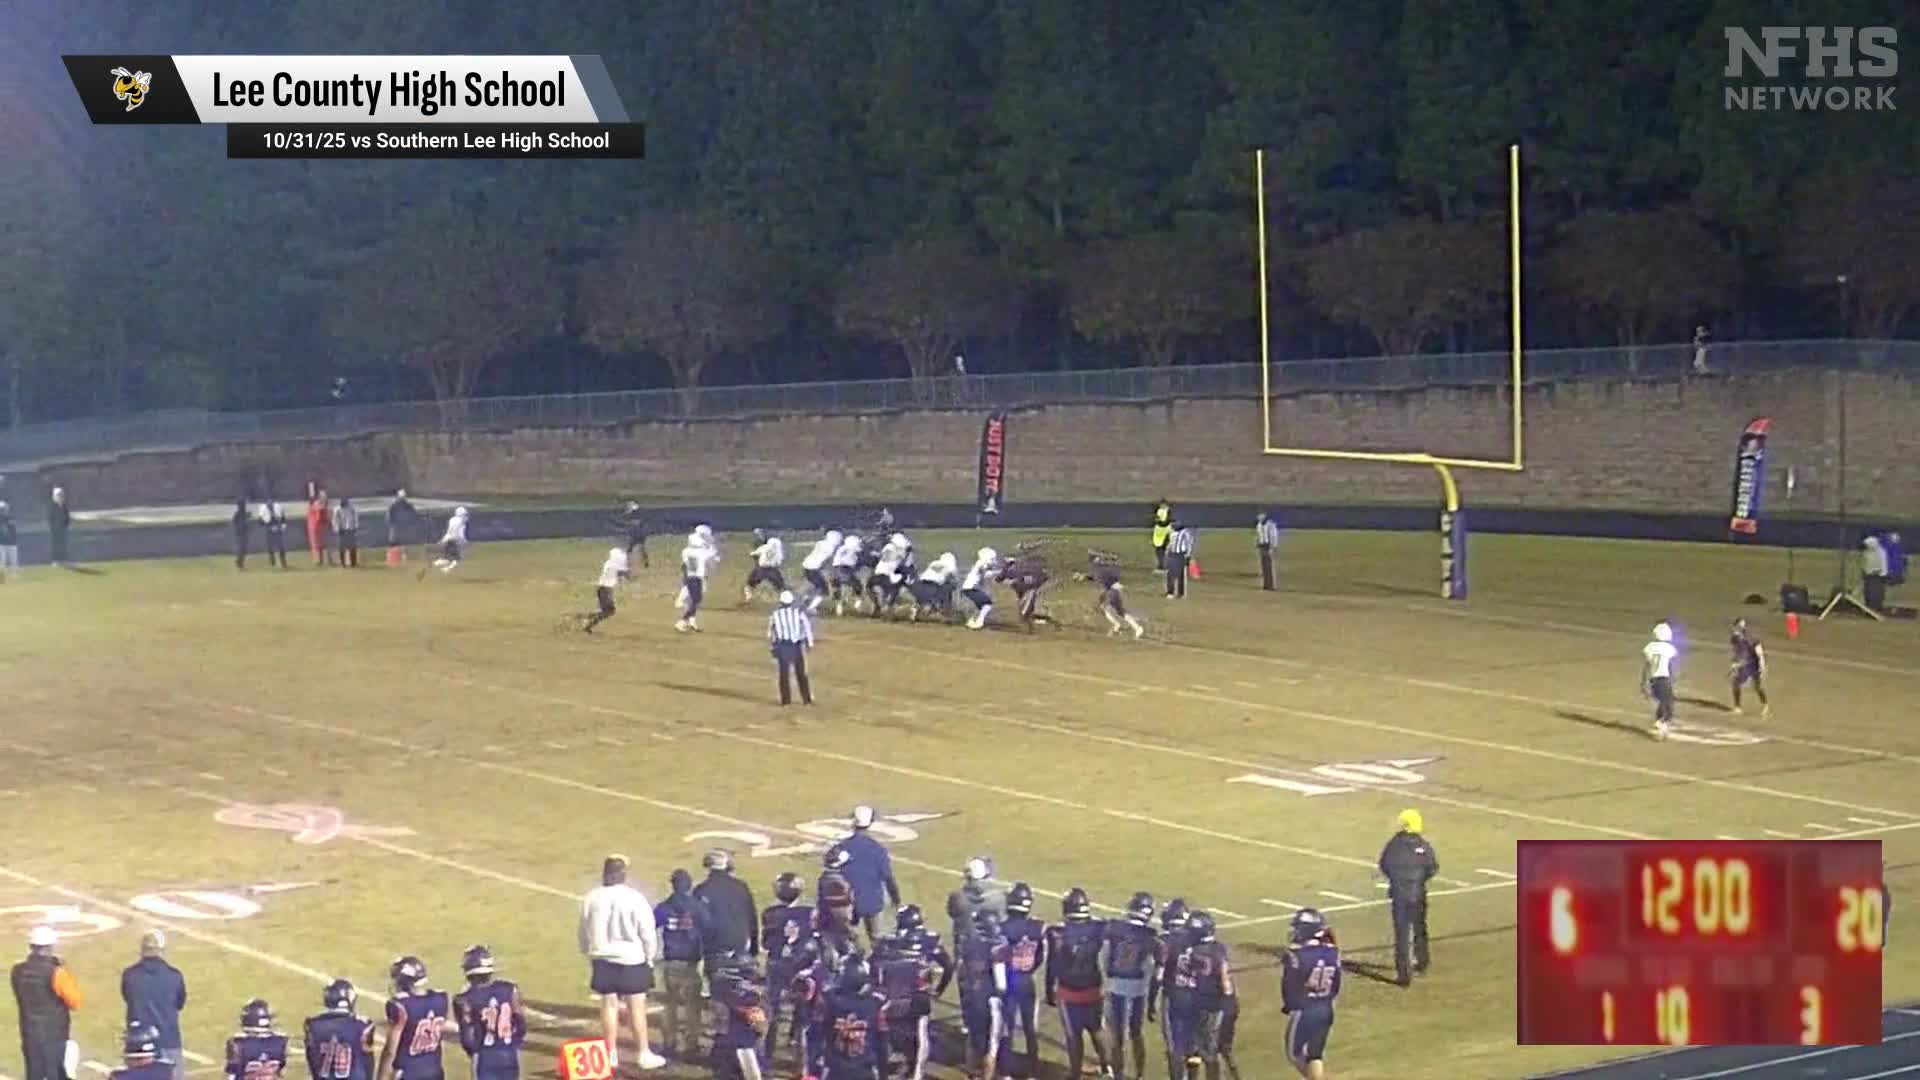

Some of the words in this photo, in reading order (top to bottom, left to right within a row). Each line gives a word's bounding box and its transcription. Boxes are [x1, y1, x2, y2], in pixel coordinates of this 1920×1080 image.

[1225, 763, 1425, 797] 10
[1550, 885, 1577, 954] 6
[1837, 885, 1883, 952] 20
[1602, 990, 1616, 1041] 1
[1655, 985, 1690, 1045] 10
[1801, 985, 1822, 1045] 3
[573, 1044, 605, 1077] 30
